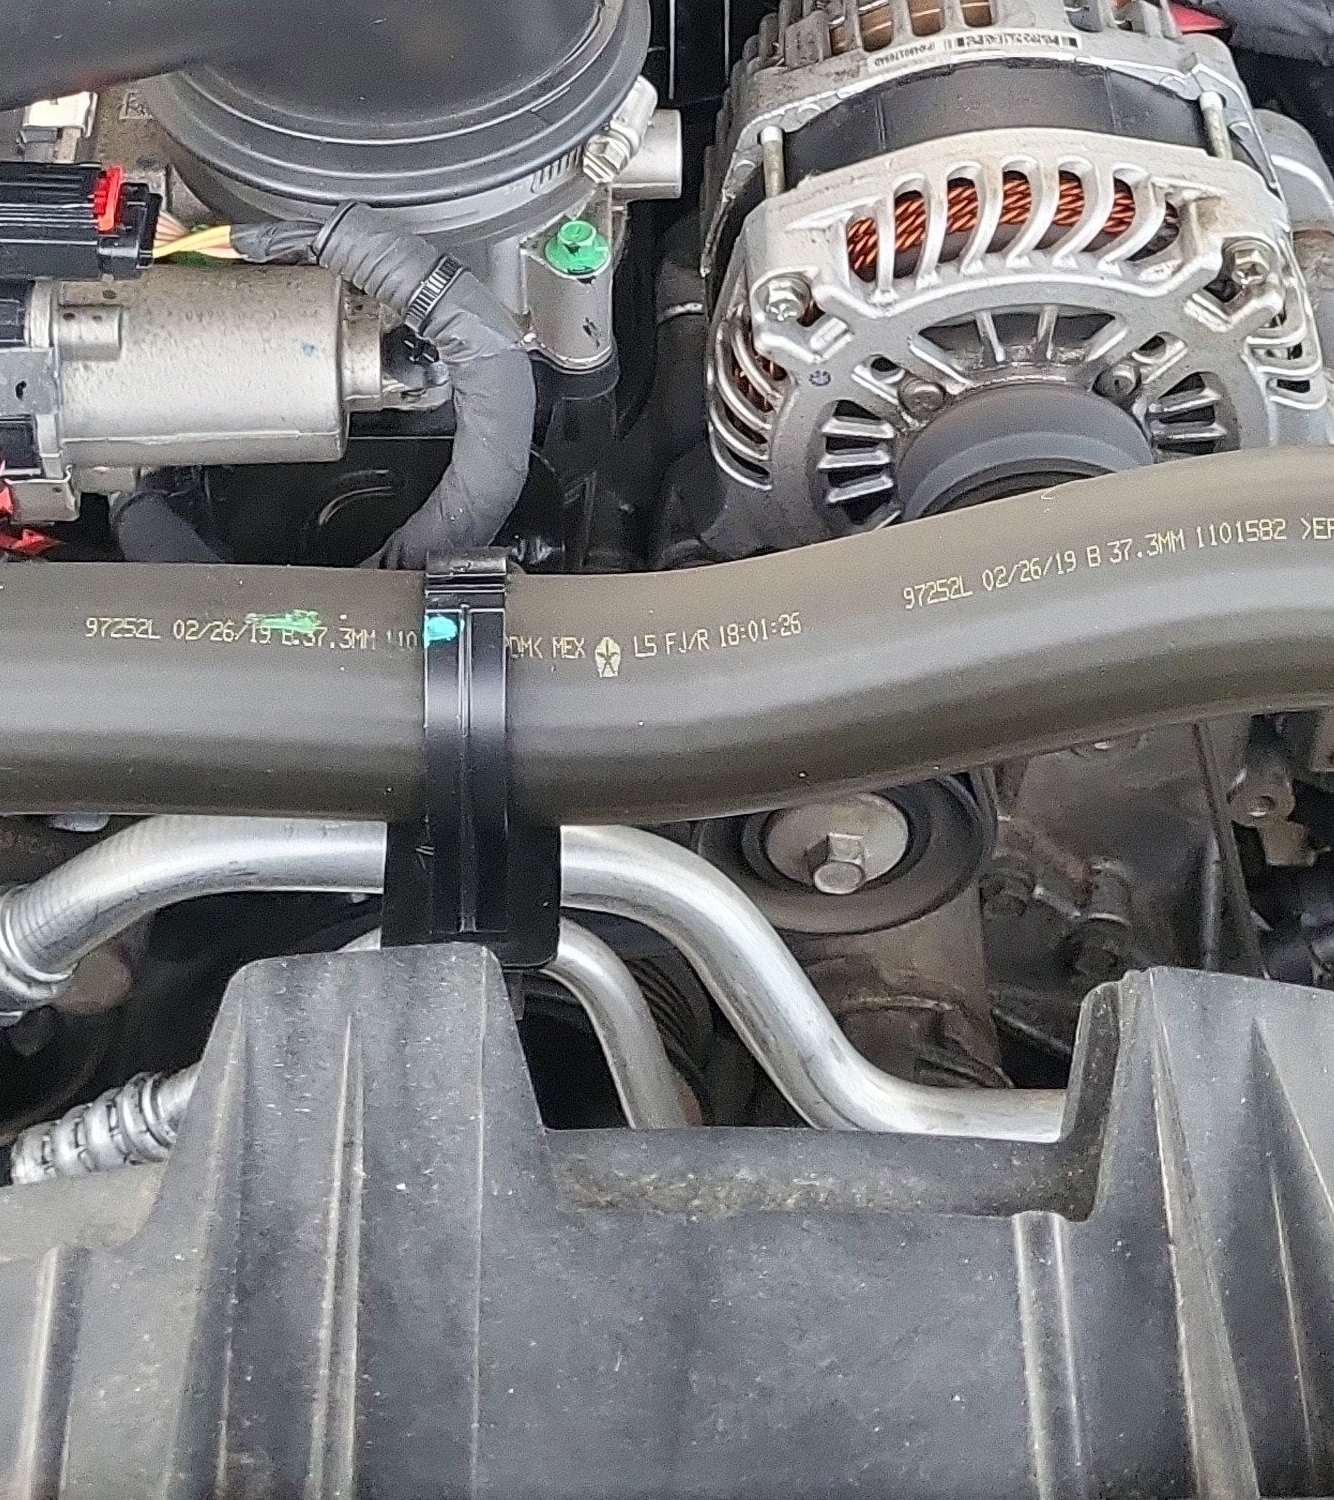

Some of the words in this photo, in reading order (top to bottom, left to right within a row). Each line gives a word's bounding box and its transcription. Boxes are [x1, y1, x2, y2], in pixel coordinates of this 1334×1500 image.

[903, 575, 973, 609] 97252L
[981, 551, 1077, 591] 02/26/19
[1087, 545, 1101, 567] B
[1107, 527, 1186, 564] 37.3MM
[1195, 518, 1287, 549] 1101582
[85, 616, 161, 640] 97252L
[172, 618, 273, 644] 02/26/19
[552, 637, 586, 659] MEX
[719, 612, 802, 649] 18:01:26
